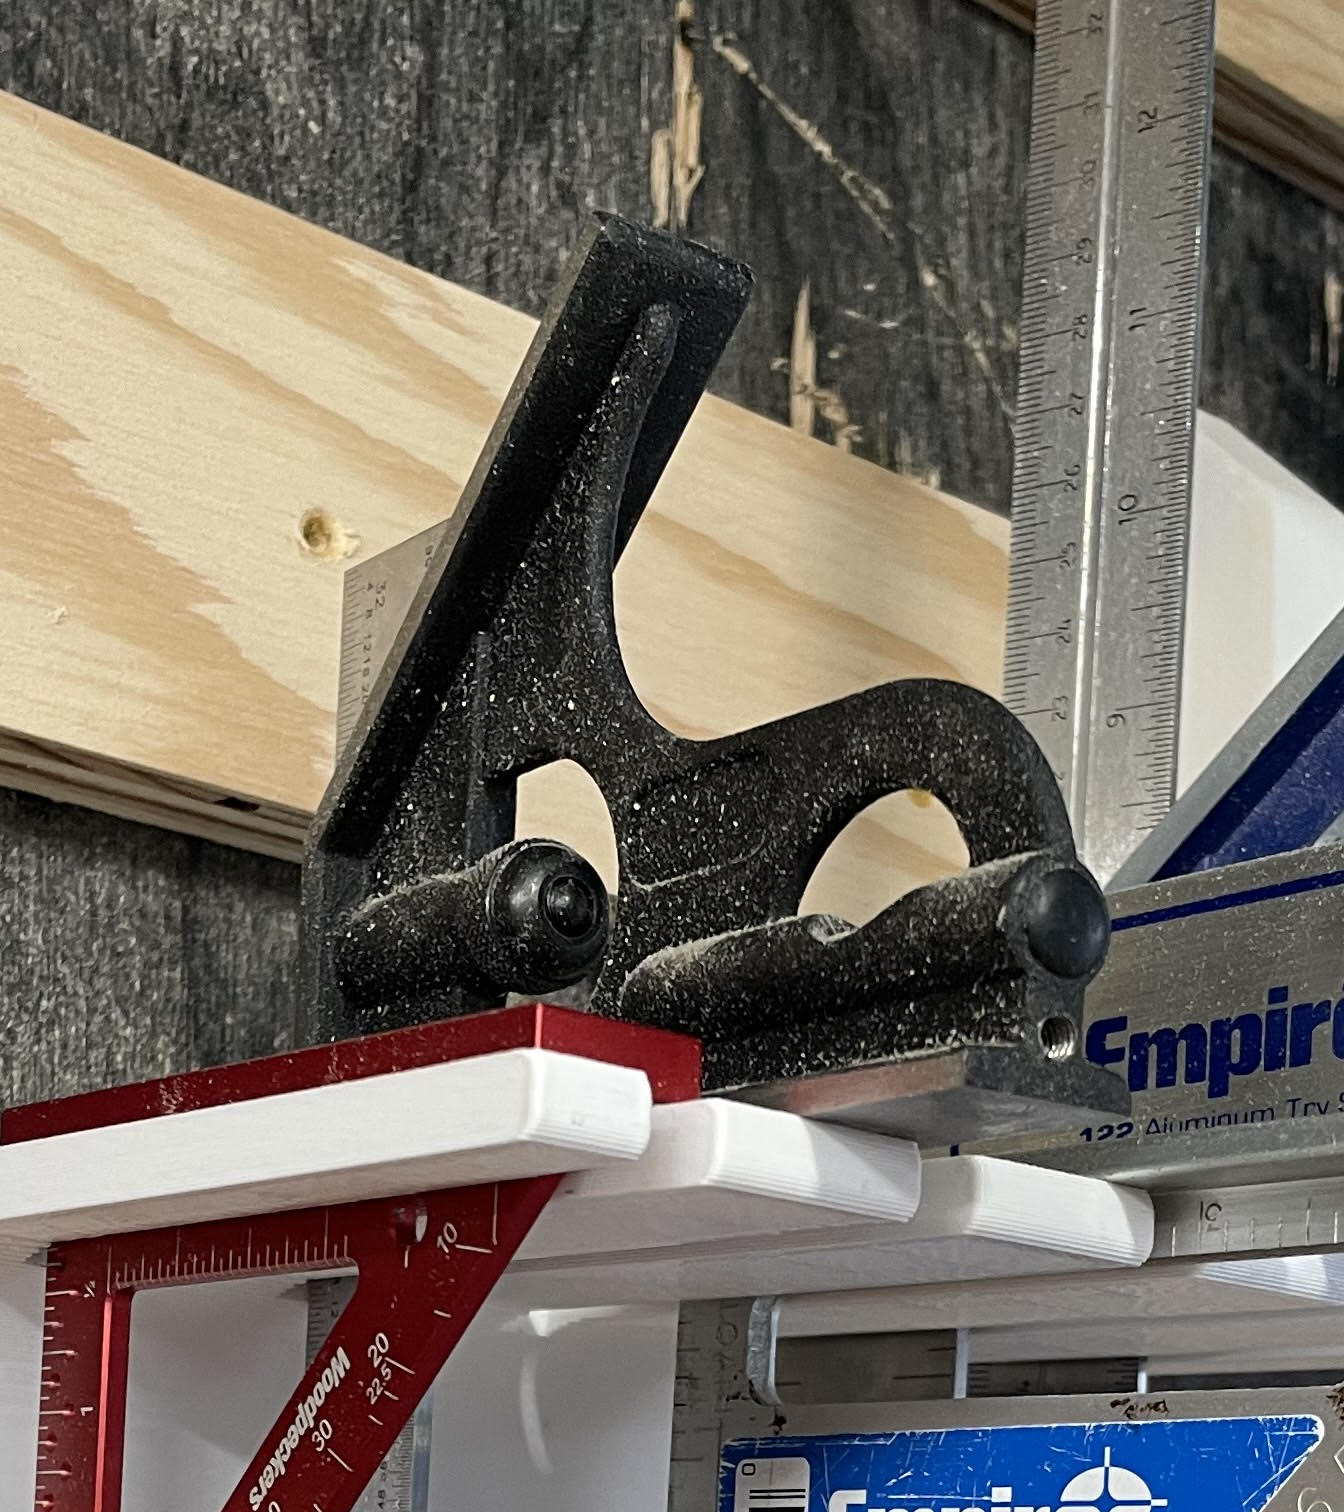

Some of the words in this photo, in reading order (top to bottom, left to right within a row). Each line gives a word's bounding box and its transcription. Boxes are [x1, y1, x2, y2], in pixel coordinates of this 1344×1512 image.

[1138, 107, 1157, 133] 12
[1117, 494, 1137, 525] 10
[437, 1223, 458, 1254] 10
[367, 1332, 390, 1368] 20
[365, 1365, 392, 1405] 22.5
[249, 1347, 352, 1512] Woodpeckers
[312, 1419, 333, 1452] 30
